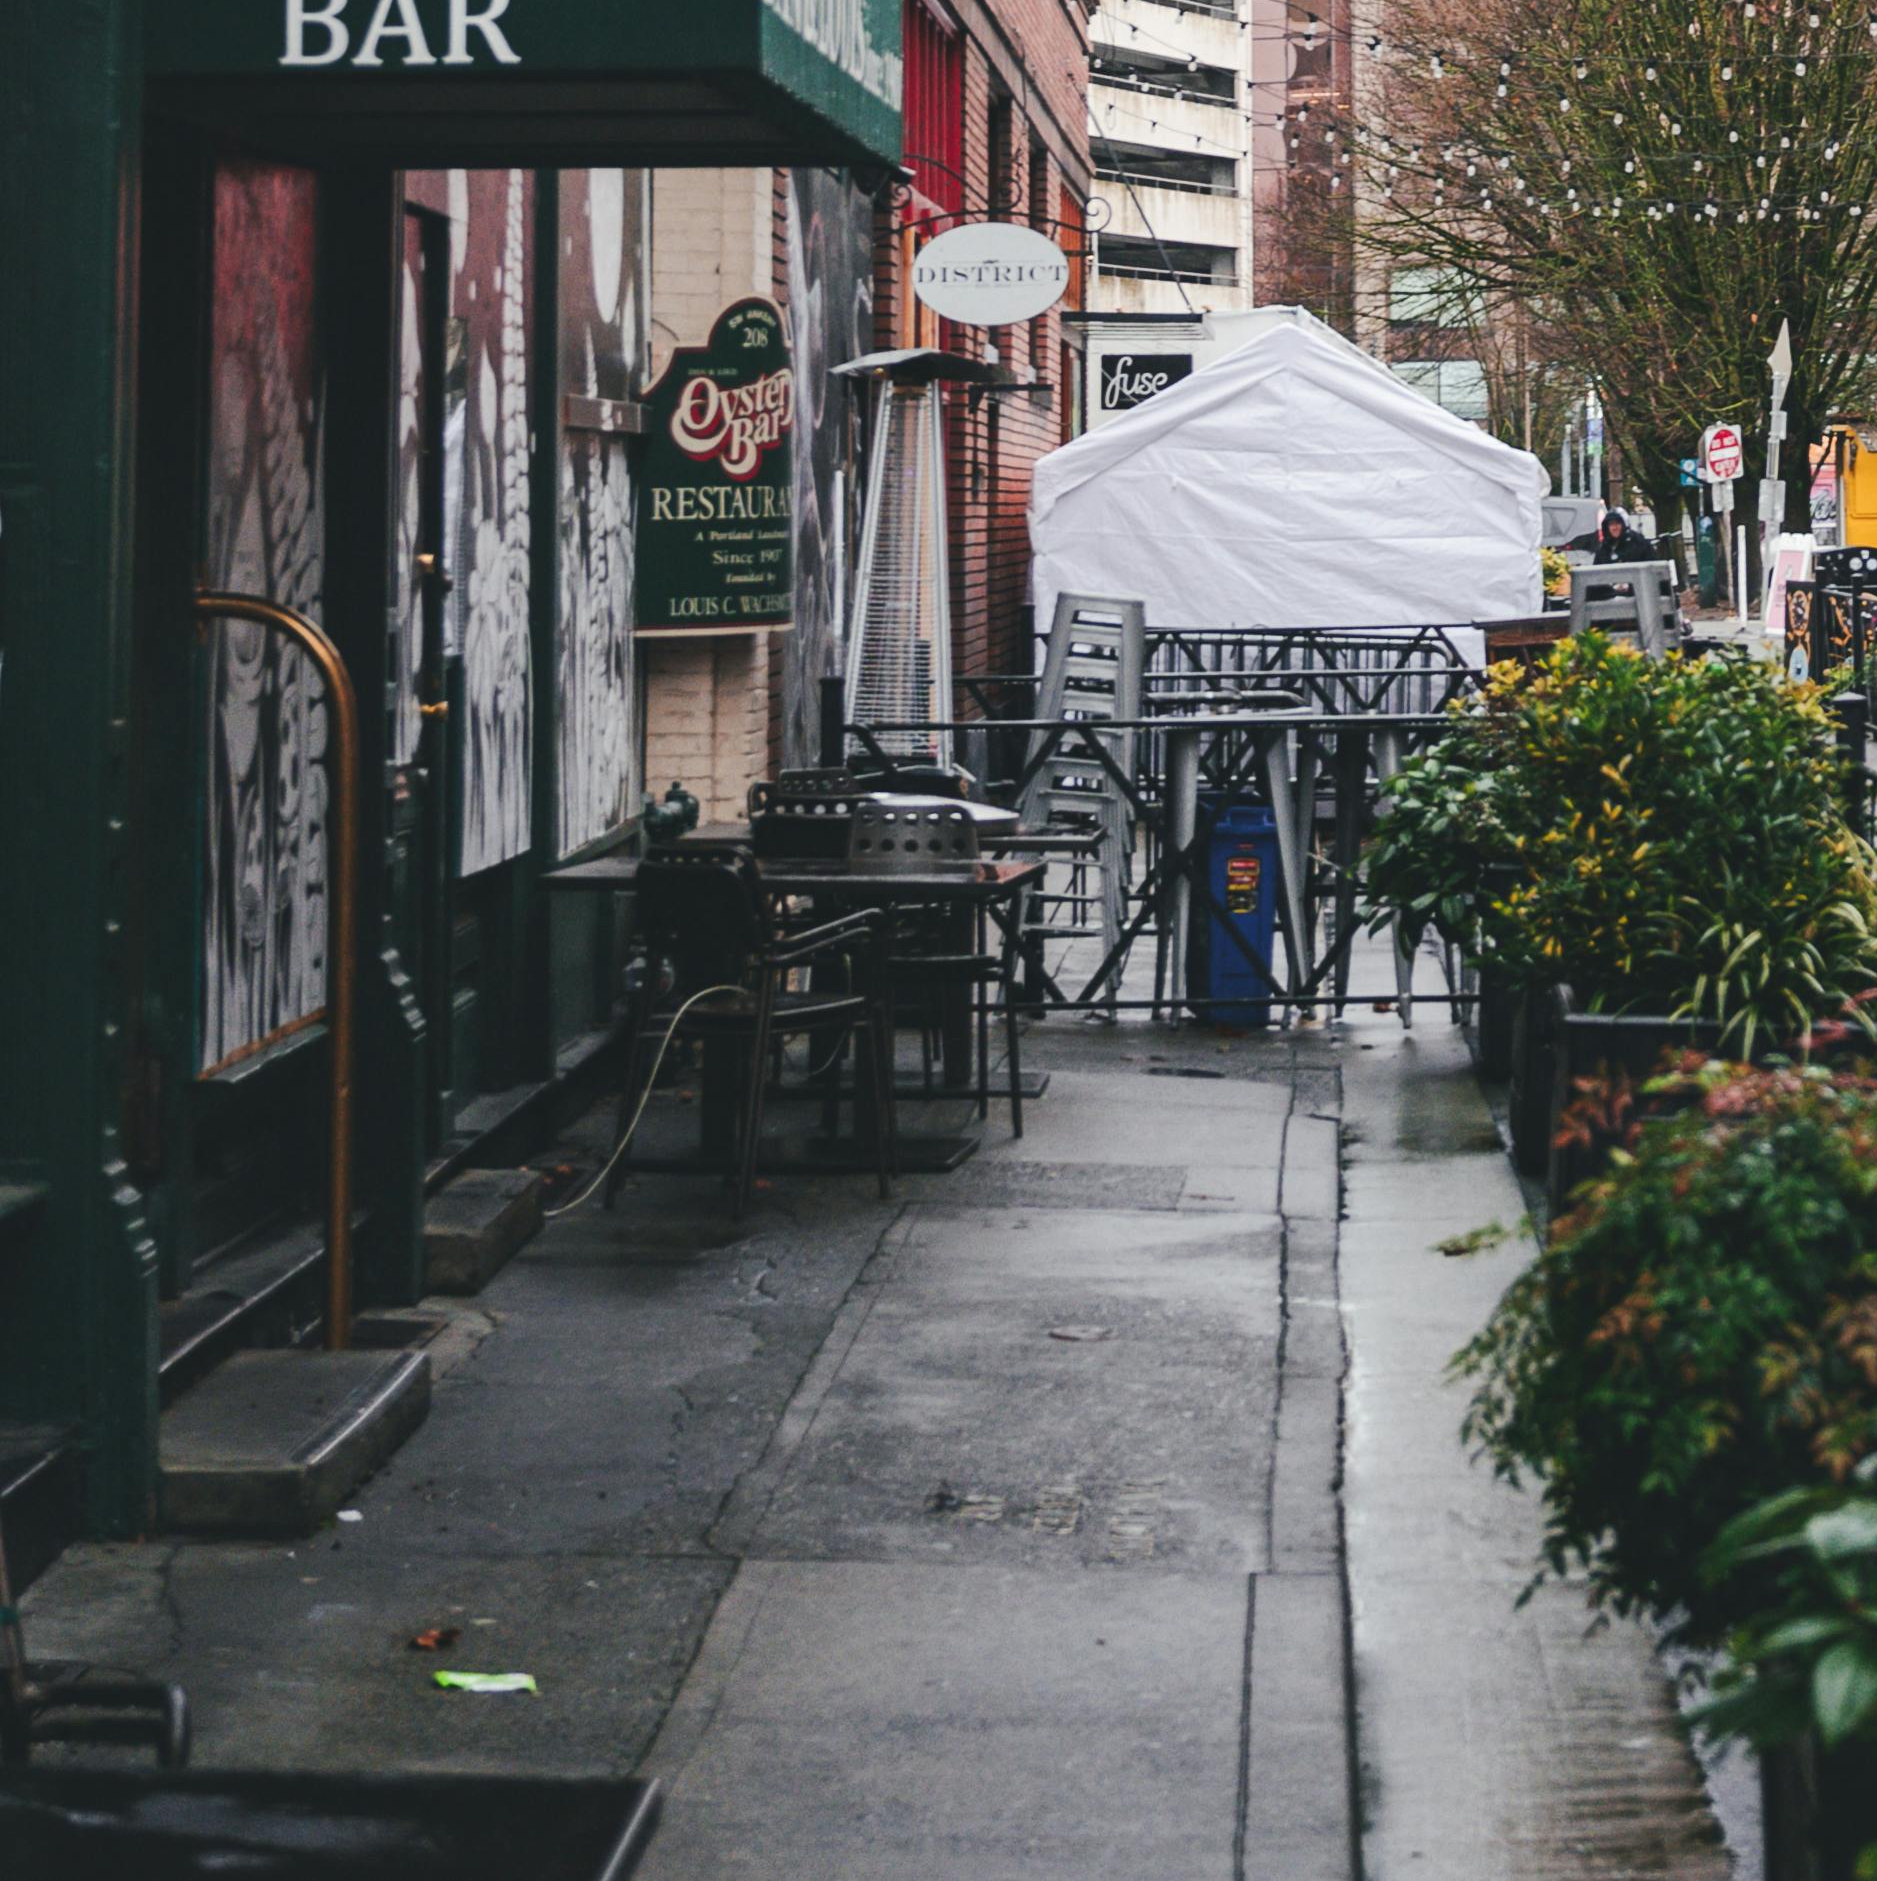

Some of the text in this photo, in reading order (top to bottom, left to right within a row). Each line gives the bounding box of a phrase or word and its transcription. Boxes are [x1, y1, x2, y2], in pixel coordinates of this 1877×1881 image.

[917, 264, 1068, 284] DISTRICT
[742, 327, 769, 348] 208
[671, 368, 795, 454] Oyster
[720, 408, 785, 475] Bar
[712, 550, 755, 566] Since
[670, 595, 720, 617] LOUIS
